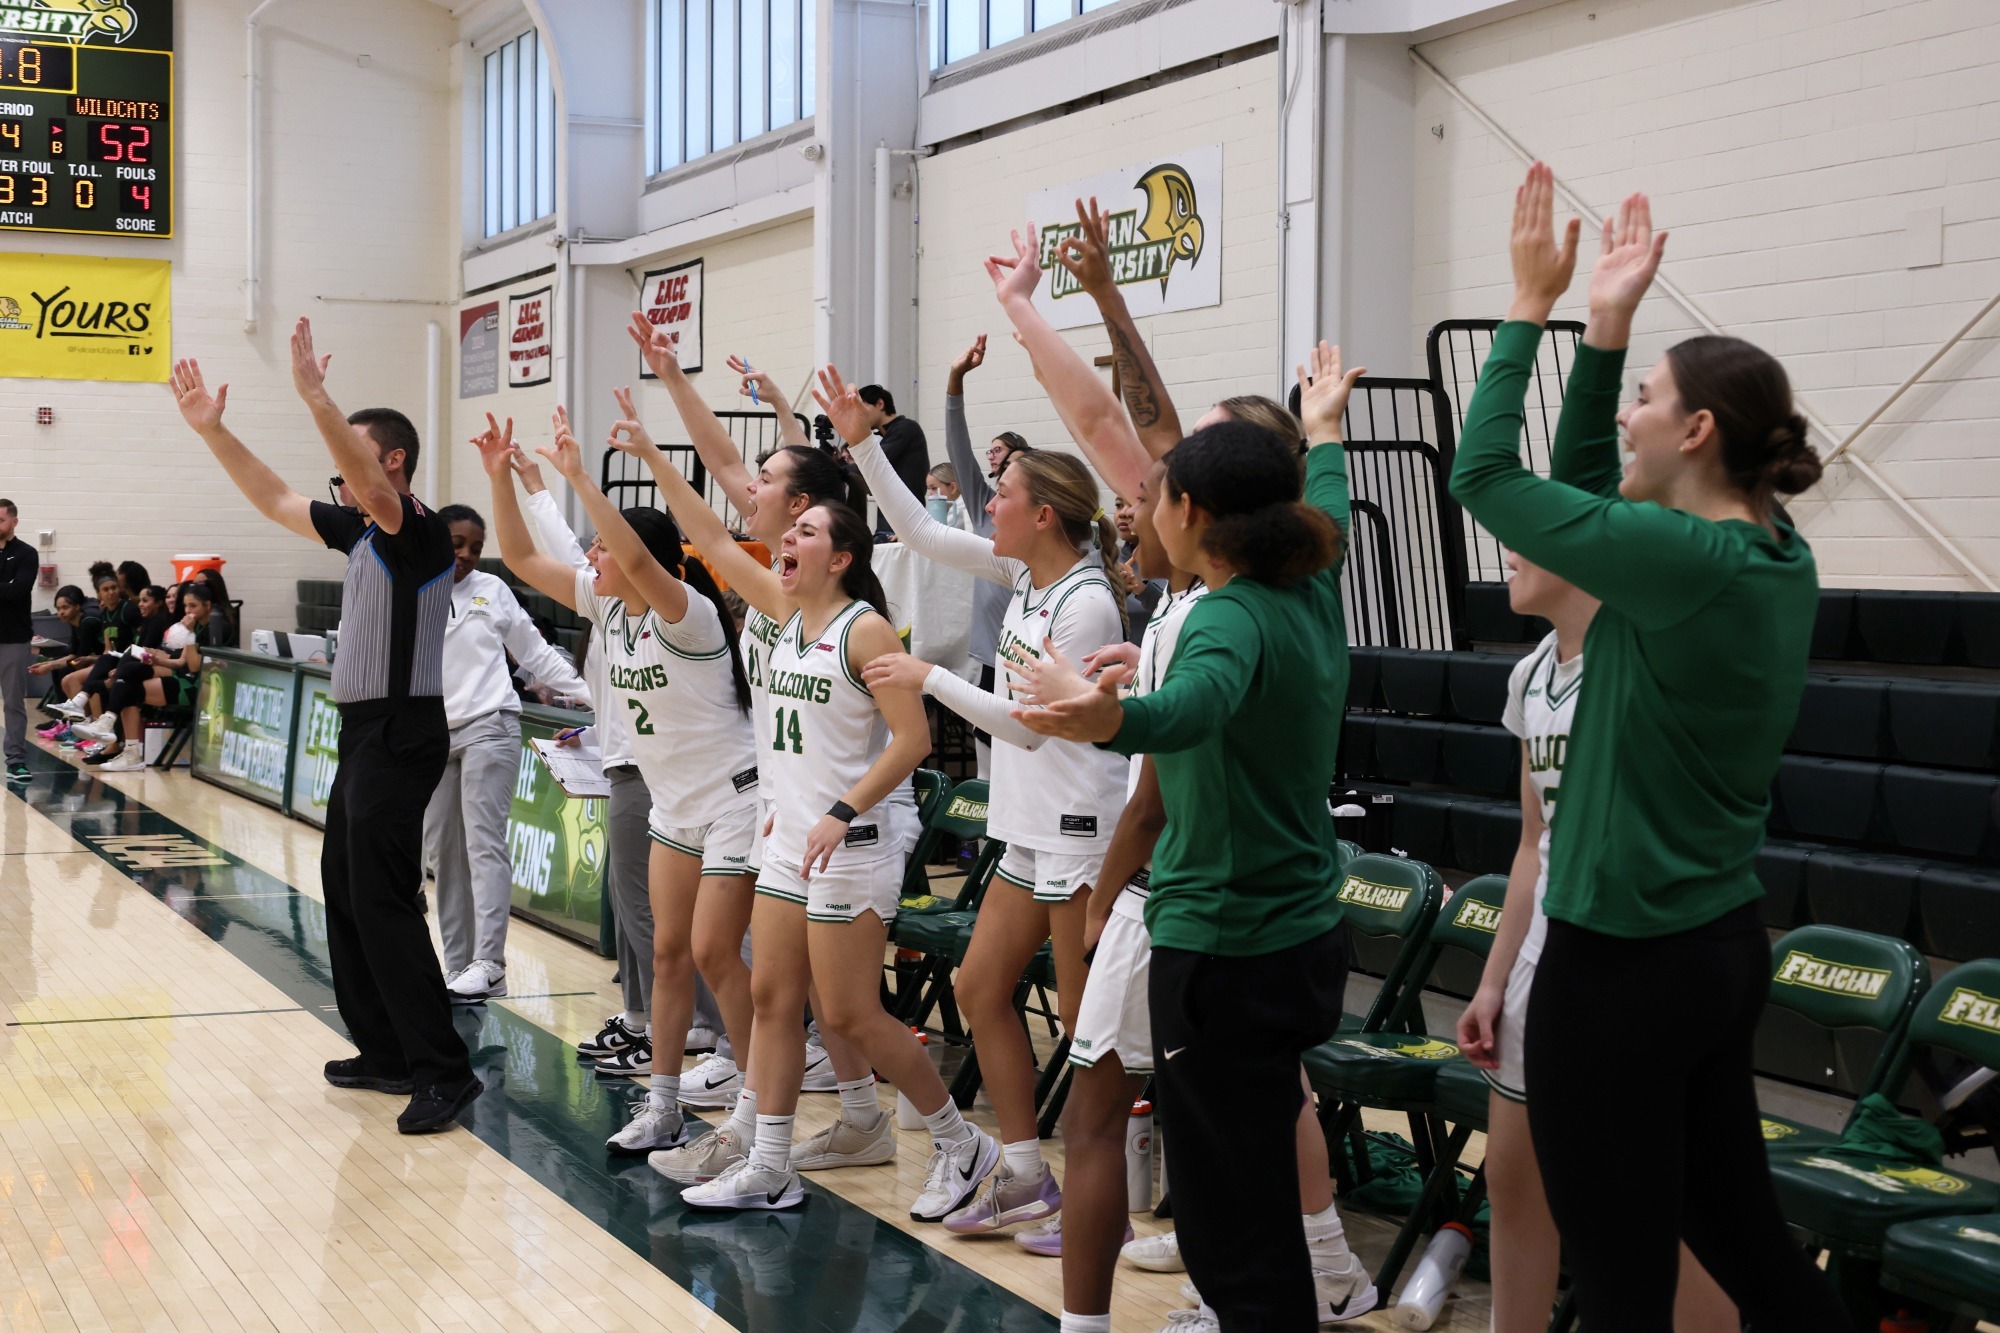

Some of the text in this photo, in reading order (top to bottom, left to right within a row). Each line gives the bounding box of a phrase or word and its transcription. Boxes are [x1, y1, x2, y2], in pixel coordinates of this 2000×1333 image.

[0, 47, 41, 84] .8
[76, 97, 159, 120] WILDCATS
[2, 123, 20, 148] 4
[52, 141, 63, 154] B
[101, 124, 150, 162] 52
[22, 161, 54, 175] FOUL
[68, 163, 102, 178] T.O.L.
[116, 167, 156, 181] FOULS
[31, 177, 47, 206] 3
[75, 180, 94, 209] 0
[131, 185, 150, 210] 4
[116, 218, 156, 231] SCORE
[30, 286, 151, 339] YOURS
[627, 698, 656, 736] 2
[772, 706, 803, 755] 14
[1338, 877, 1409, 909] FELICIAN
[825, 903, 852, 911] capelli
[1779, 953, 1888, 996] FELICIAN
